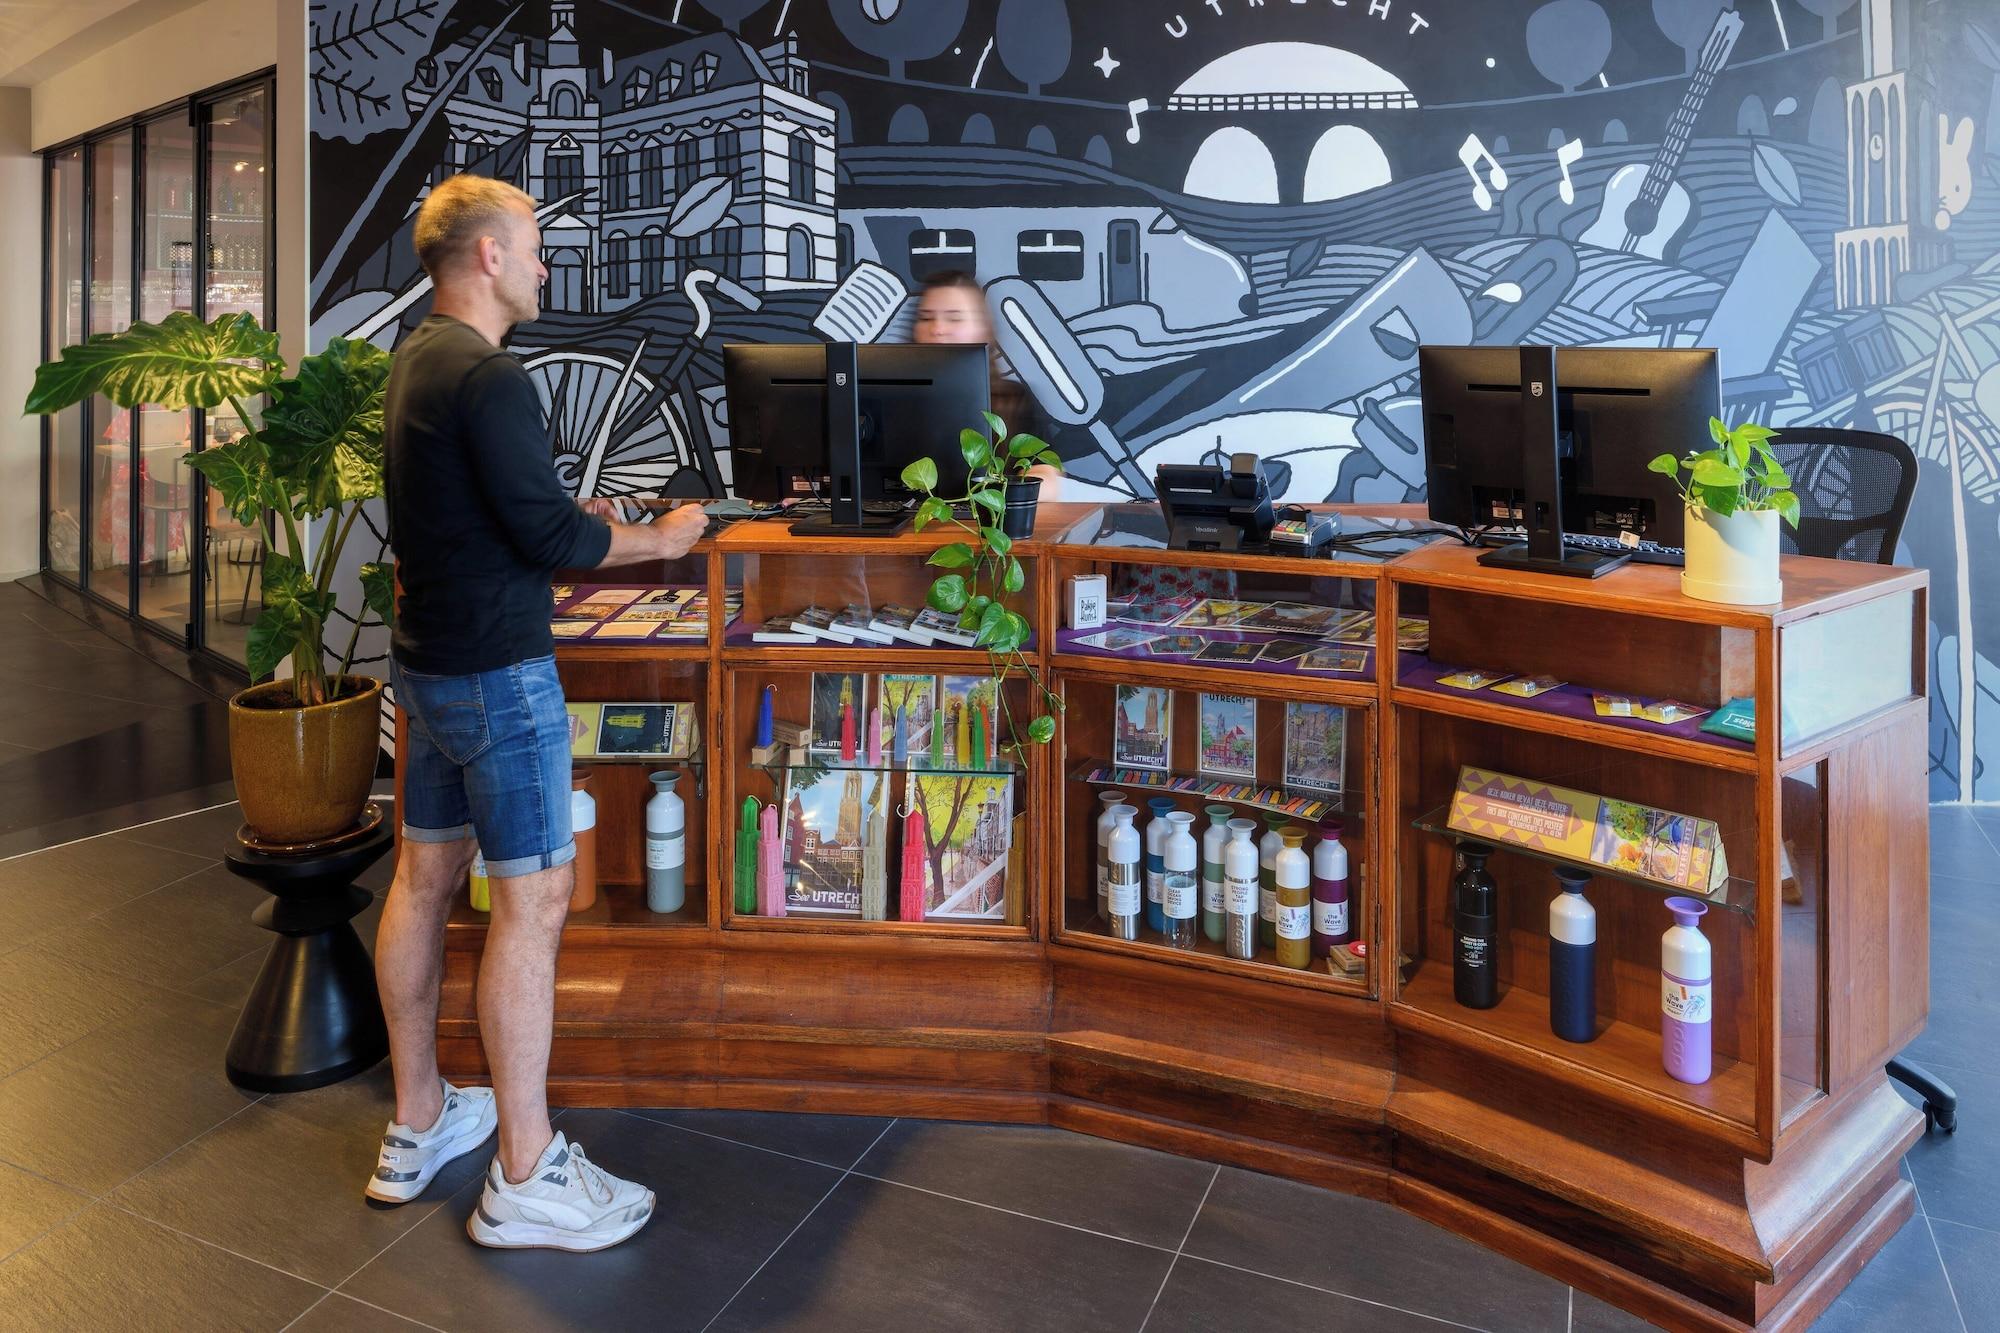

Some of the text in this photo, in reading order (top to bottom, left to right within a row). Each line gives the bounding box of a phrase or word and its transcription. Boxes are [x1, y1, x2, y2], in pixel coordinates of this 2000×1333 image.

[1209, 694, 1246, 704] UTRECHT
[663, 709, 673, 737] UTRECHT
[1133, 755, 1163, 765] UTRECHT
[1296, 778, 1329, 788] UTRECHT
[788, 888, 860, 904] See UTRECH
[1280, 915, 1290, 923] the
[1669, 992, 1680, 1002] the
[1666, 997, 1684, 1010] Wave
